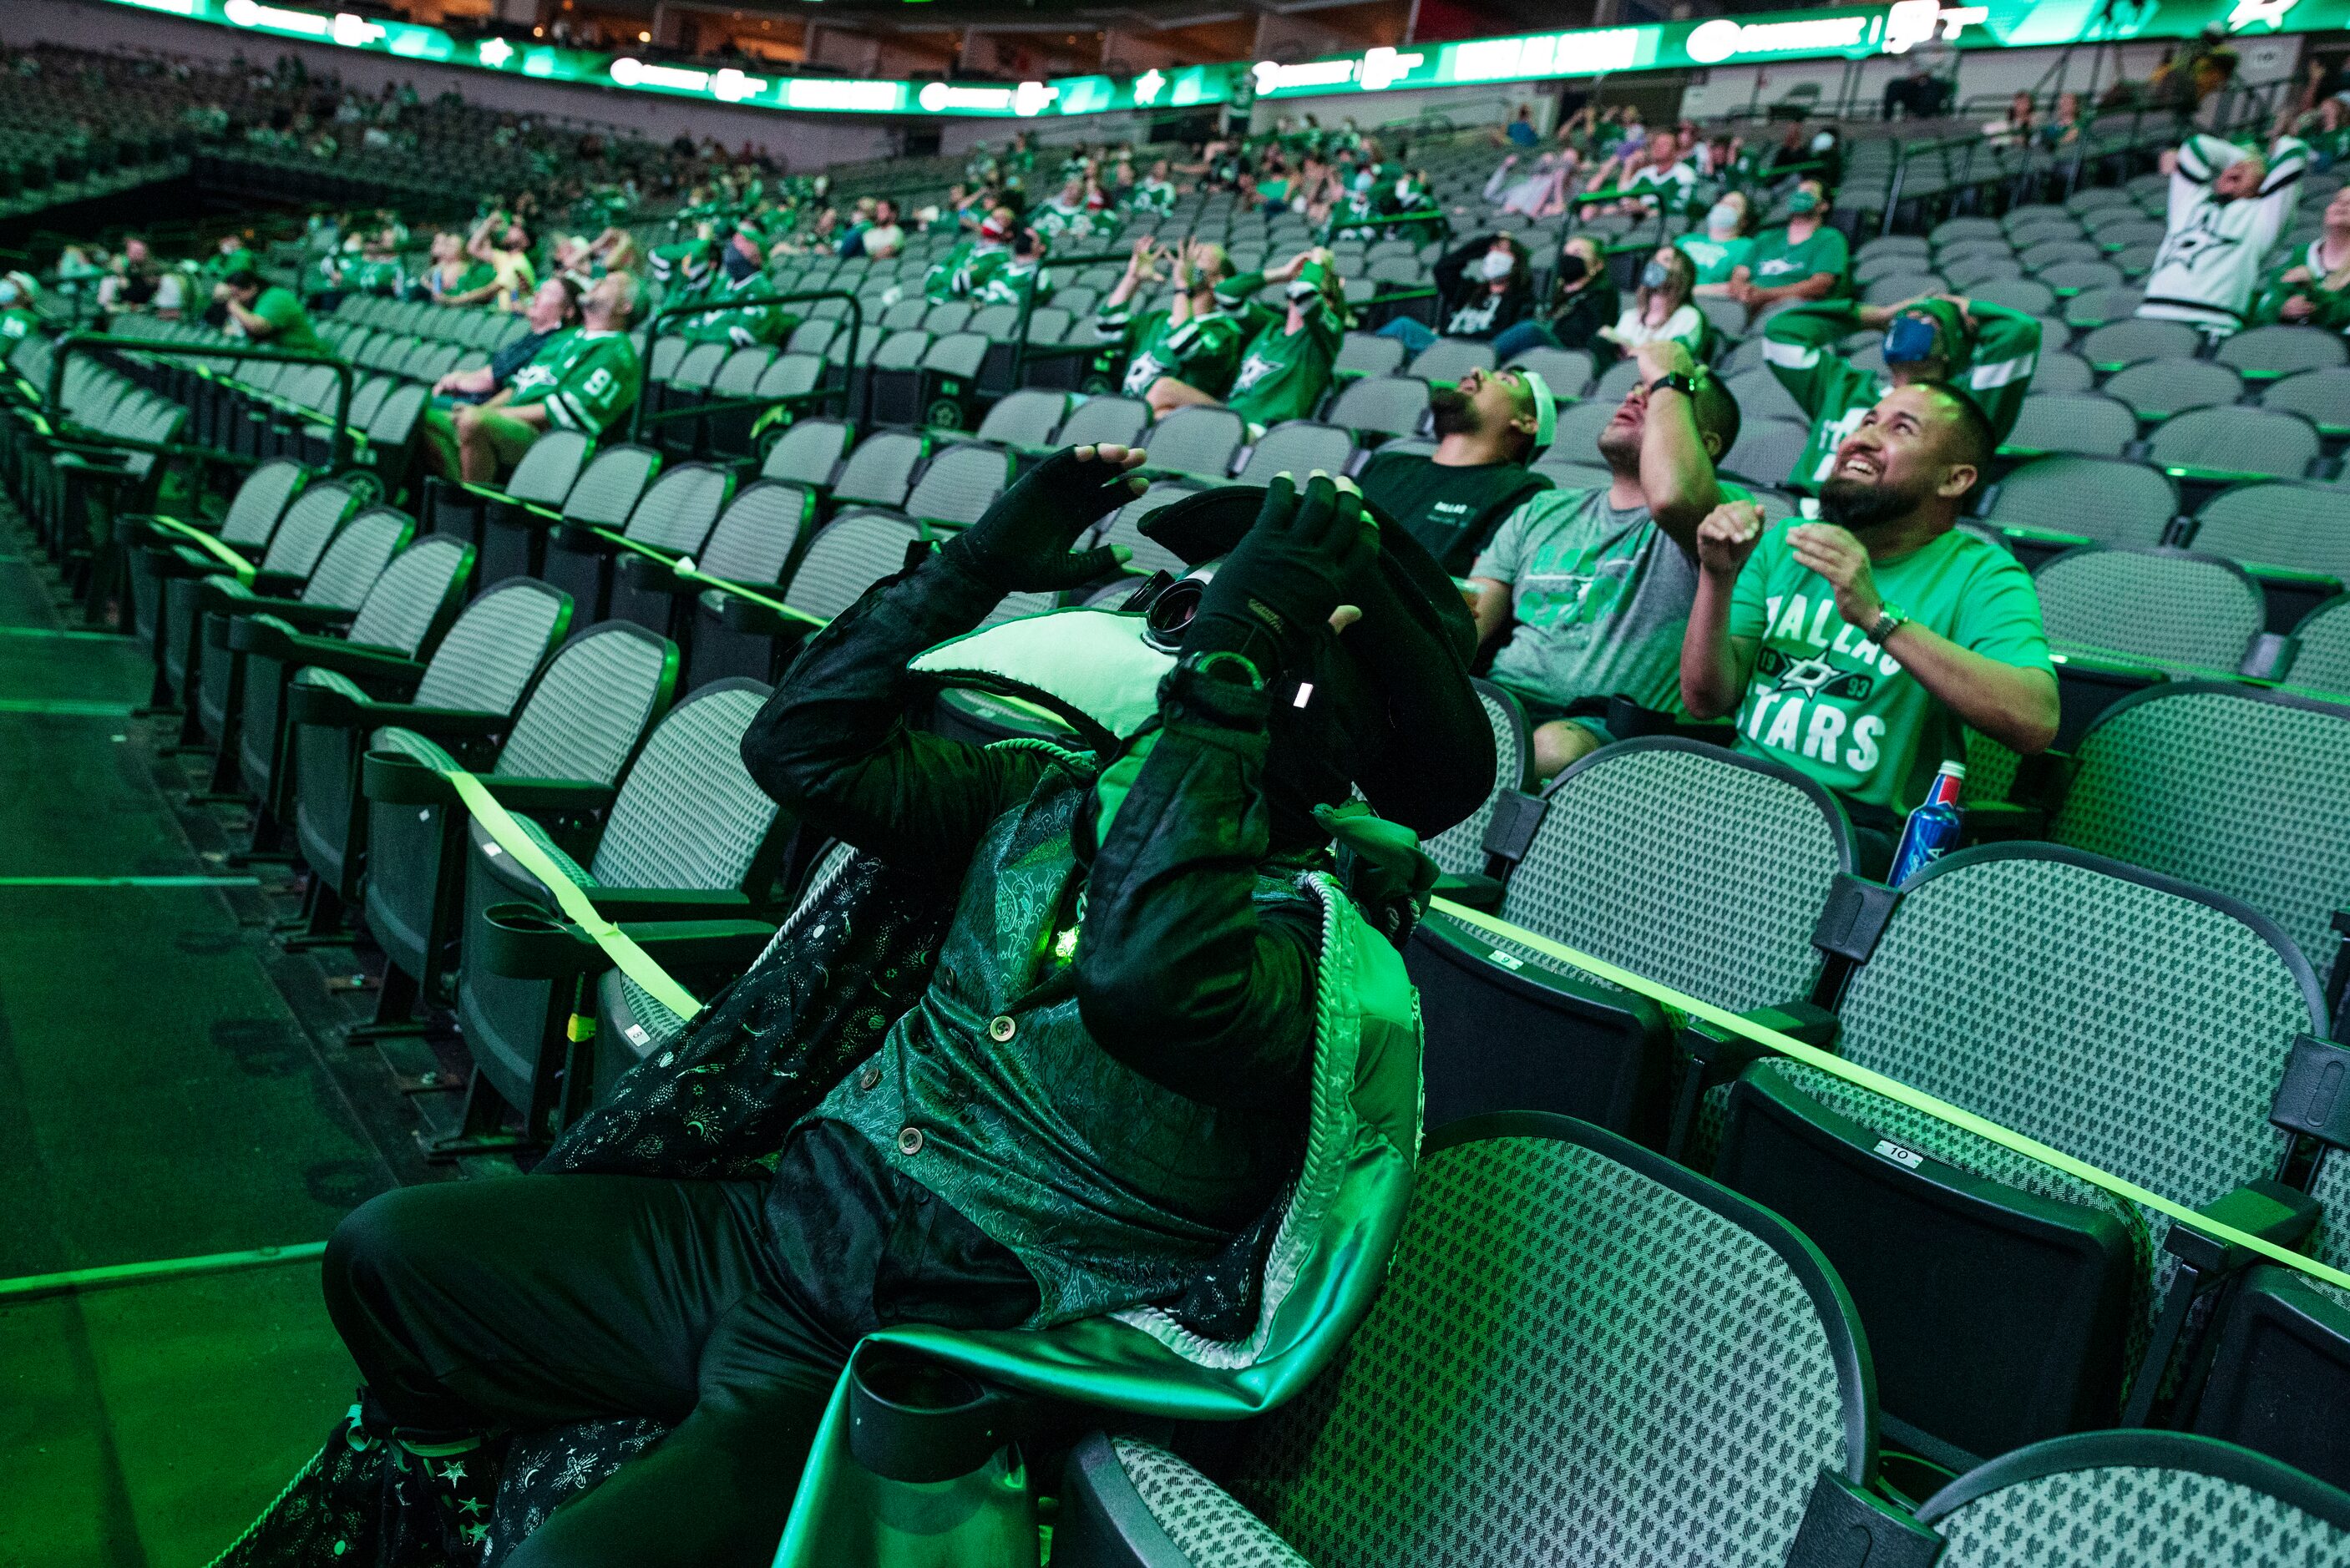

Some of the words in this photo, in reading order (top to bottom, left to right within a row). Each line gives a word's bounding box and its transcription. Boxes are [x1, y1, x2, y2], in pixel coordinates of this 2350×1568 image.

[583, 367, 620, 408] 91
[1760, 650, 1777, 671] 19
[1846, 678, 1870, 698] 93
[1737, 683, 1886, 772] TARS
[1891, 1147, 1908, 1159] 10
